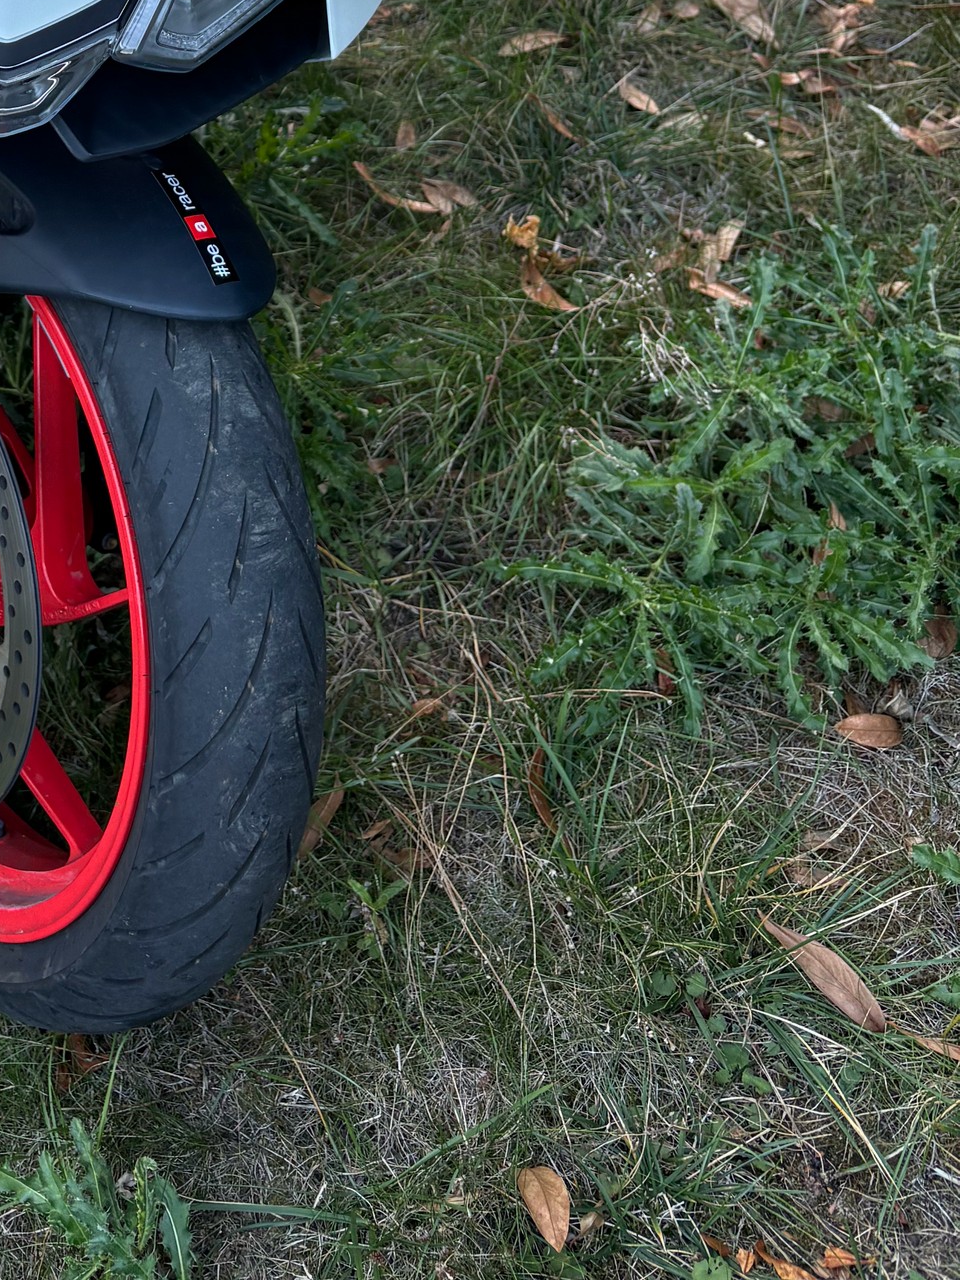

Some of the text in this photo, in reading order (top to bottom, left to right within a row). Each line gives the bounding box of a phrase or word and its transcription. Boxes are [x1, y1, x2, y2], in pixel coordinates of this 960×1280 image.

[162, 172, 231, 277] #be a racer
